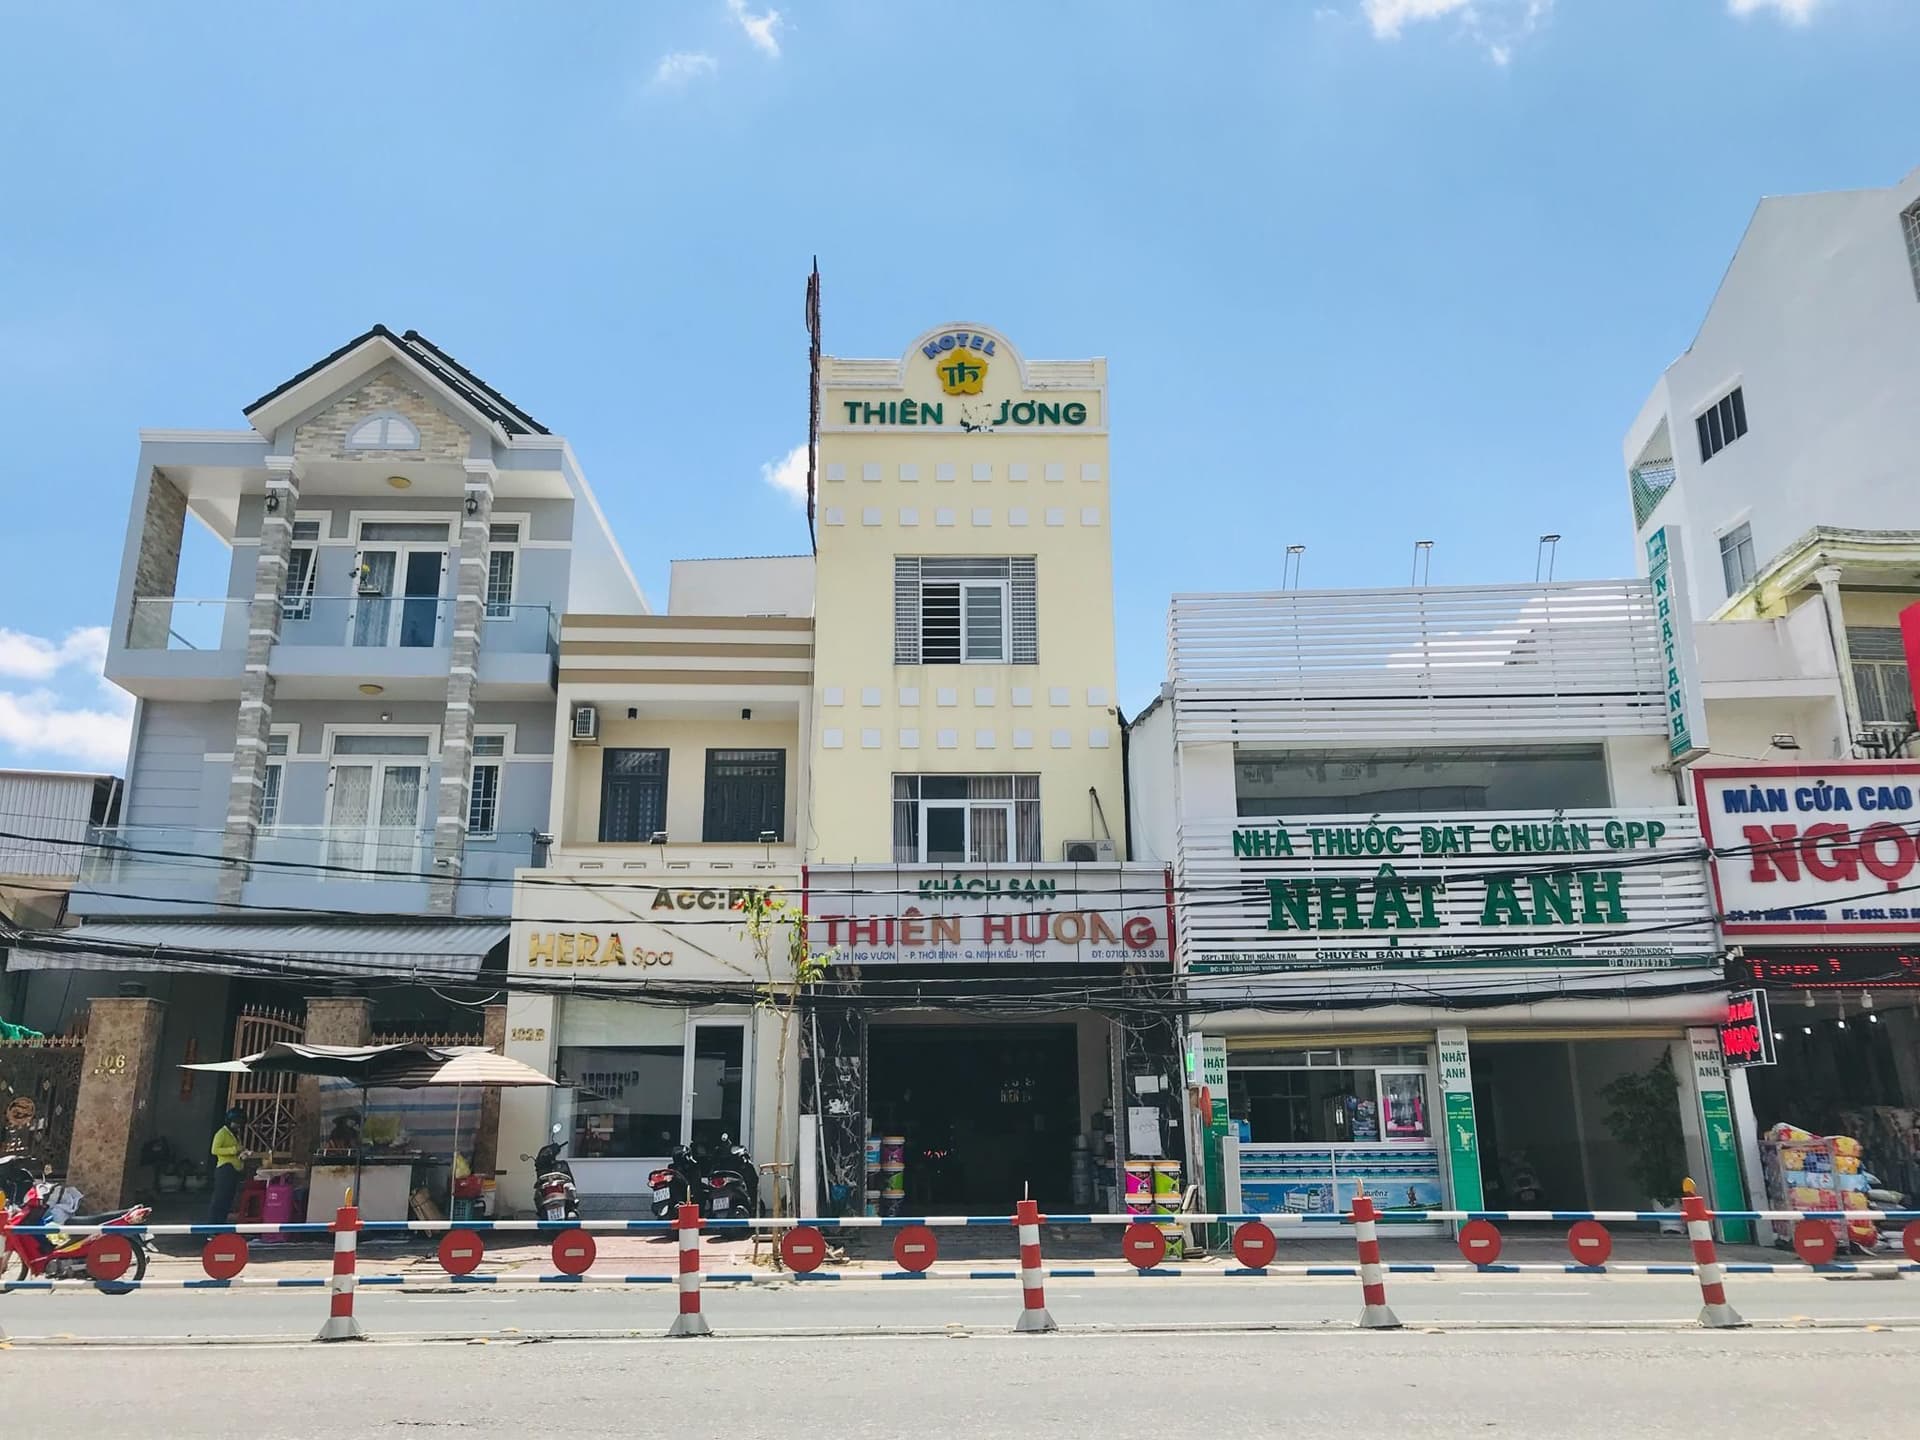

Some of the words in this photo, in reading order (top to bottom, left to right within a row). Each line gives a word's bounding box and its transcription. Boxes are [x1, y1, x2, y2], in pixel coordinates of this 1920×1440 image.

[923, 333, 995, 359] HOTEL
[844, 399, 943, 425] THIÊN
[1722, 784, 1788, 814] MÀN
[1795, 780, 1853, 812] CỬA
[1858, 786, 1913, 811] CAO
[1232, 819, 1294, 857] NHÀ
[1306, 813, 1405, 857] THUỐC
[1604, 821, 1666, 849] GPP
[1743, 822, 1920, 894] NGỌ
[918, 874, 1001, 900] KHÁCH
[1009, 878, 1057, 903] SẠN
[1264, 862, 1446, 946] NHẬT
[1480, 872, 1628, 926] ANH
[820, 906, 961, 947] THIÊN
[983, 907, 1157, 950] HƯƠNG
[528, 932, 627, 967] HERA
[632, 946, 674, 970] Spa
[1442, 1050, 1467, 1065] NHẬT
[1698, 1066, 1720, 1077] ANH
[1446, 1069, 1466, 1079] ANH
